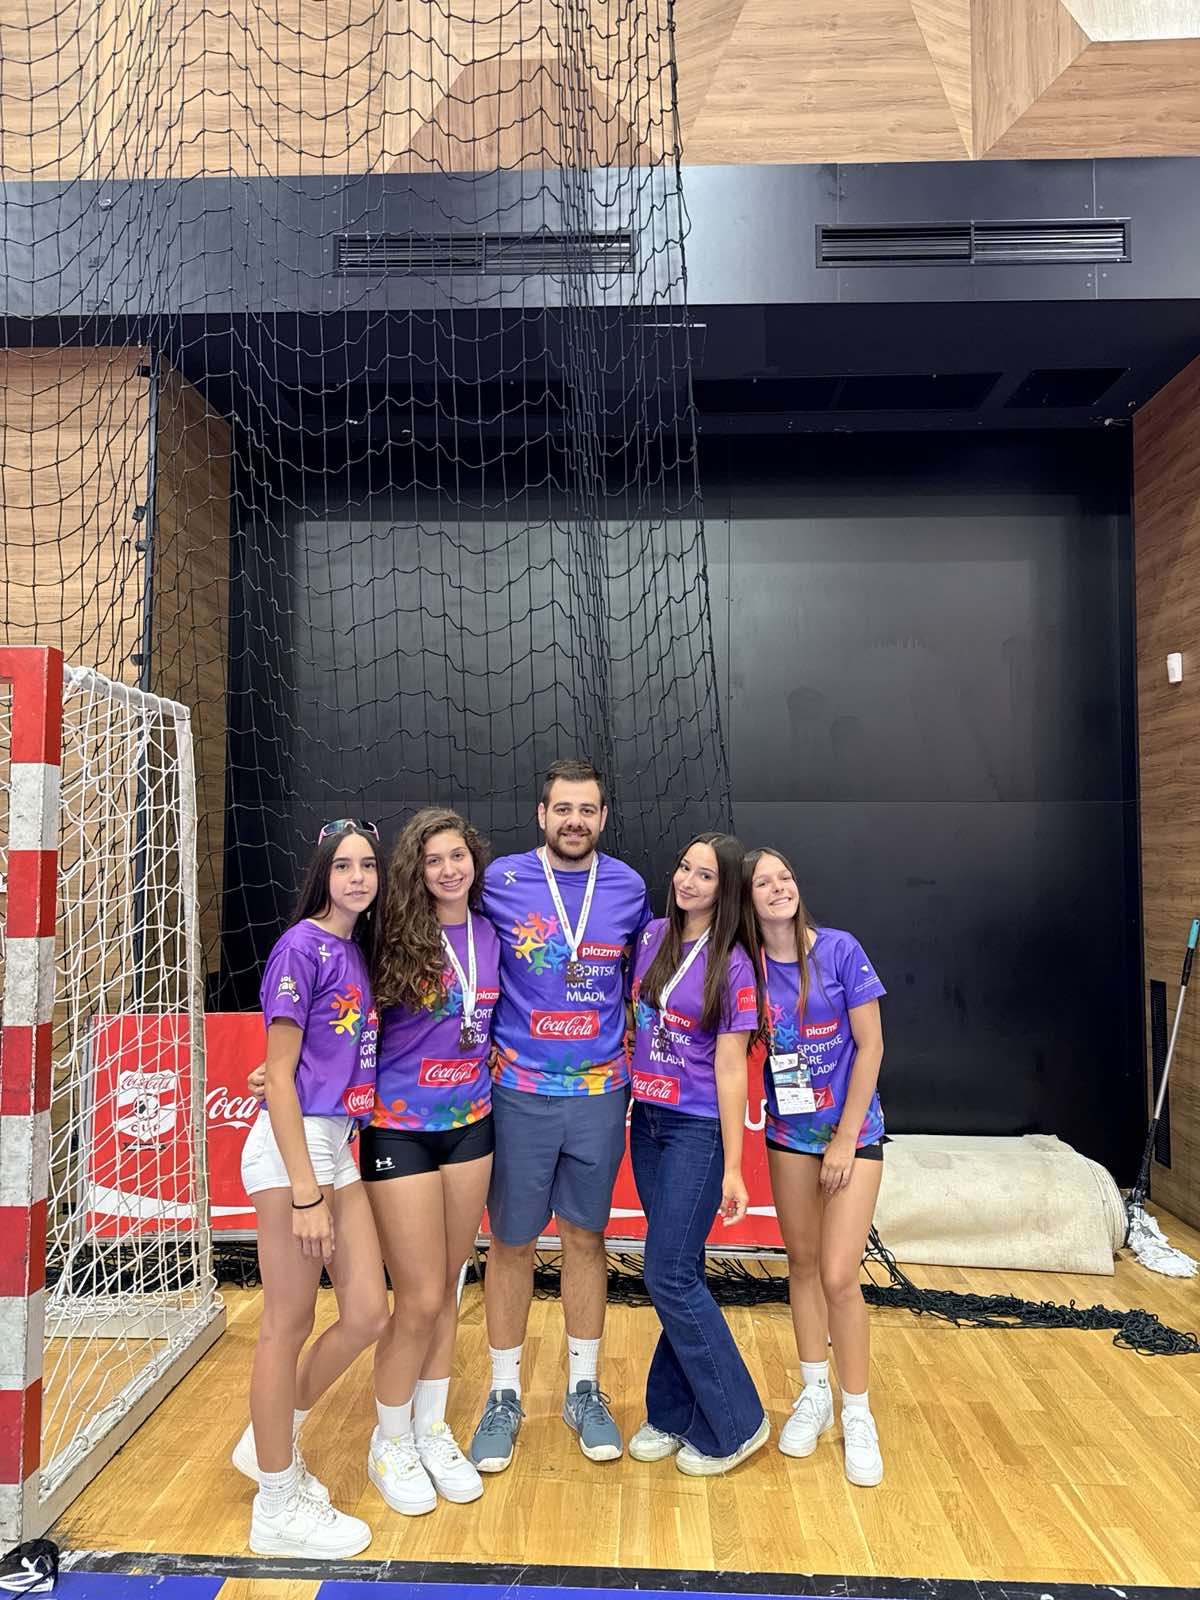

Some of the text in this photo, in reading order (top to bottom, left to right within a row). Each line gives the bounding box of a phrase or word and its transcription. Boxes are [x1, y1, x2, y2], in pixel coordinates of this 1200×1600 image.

[582, 946, 621, 958] plazma
[665, 1013, 691, 1028] azma
[653, 1025, 692, 1046] STSKE
